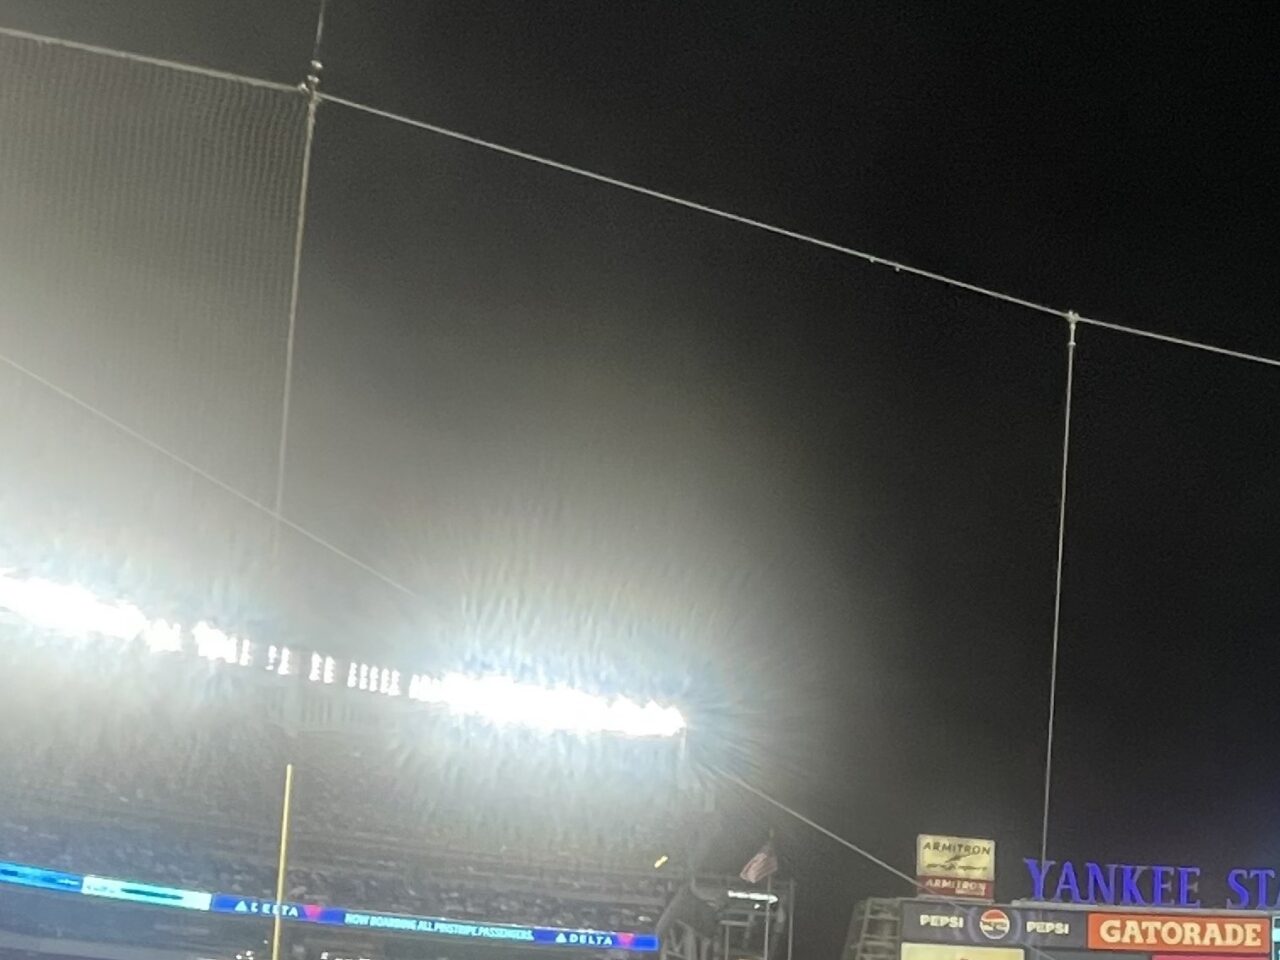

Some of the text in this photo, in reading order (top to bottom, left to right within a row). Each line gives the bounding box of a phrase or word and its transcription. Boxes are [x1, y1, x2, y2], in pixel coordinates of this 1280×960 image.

[923, 842, 991, 855] ARMITRON
[1023, 858, 1200, 908] YANKEE
[920, 914, 964, 928] PEPSI
[1026, 921, 1070, 934] PEPSI
[1099, 919, 1262, 946] GATORADE
[570, 933, 613, 946] DELTA
